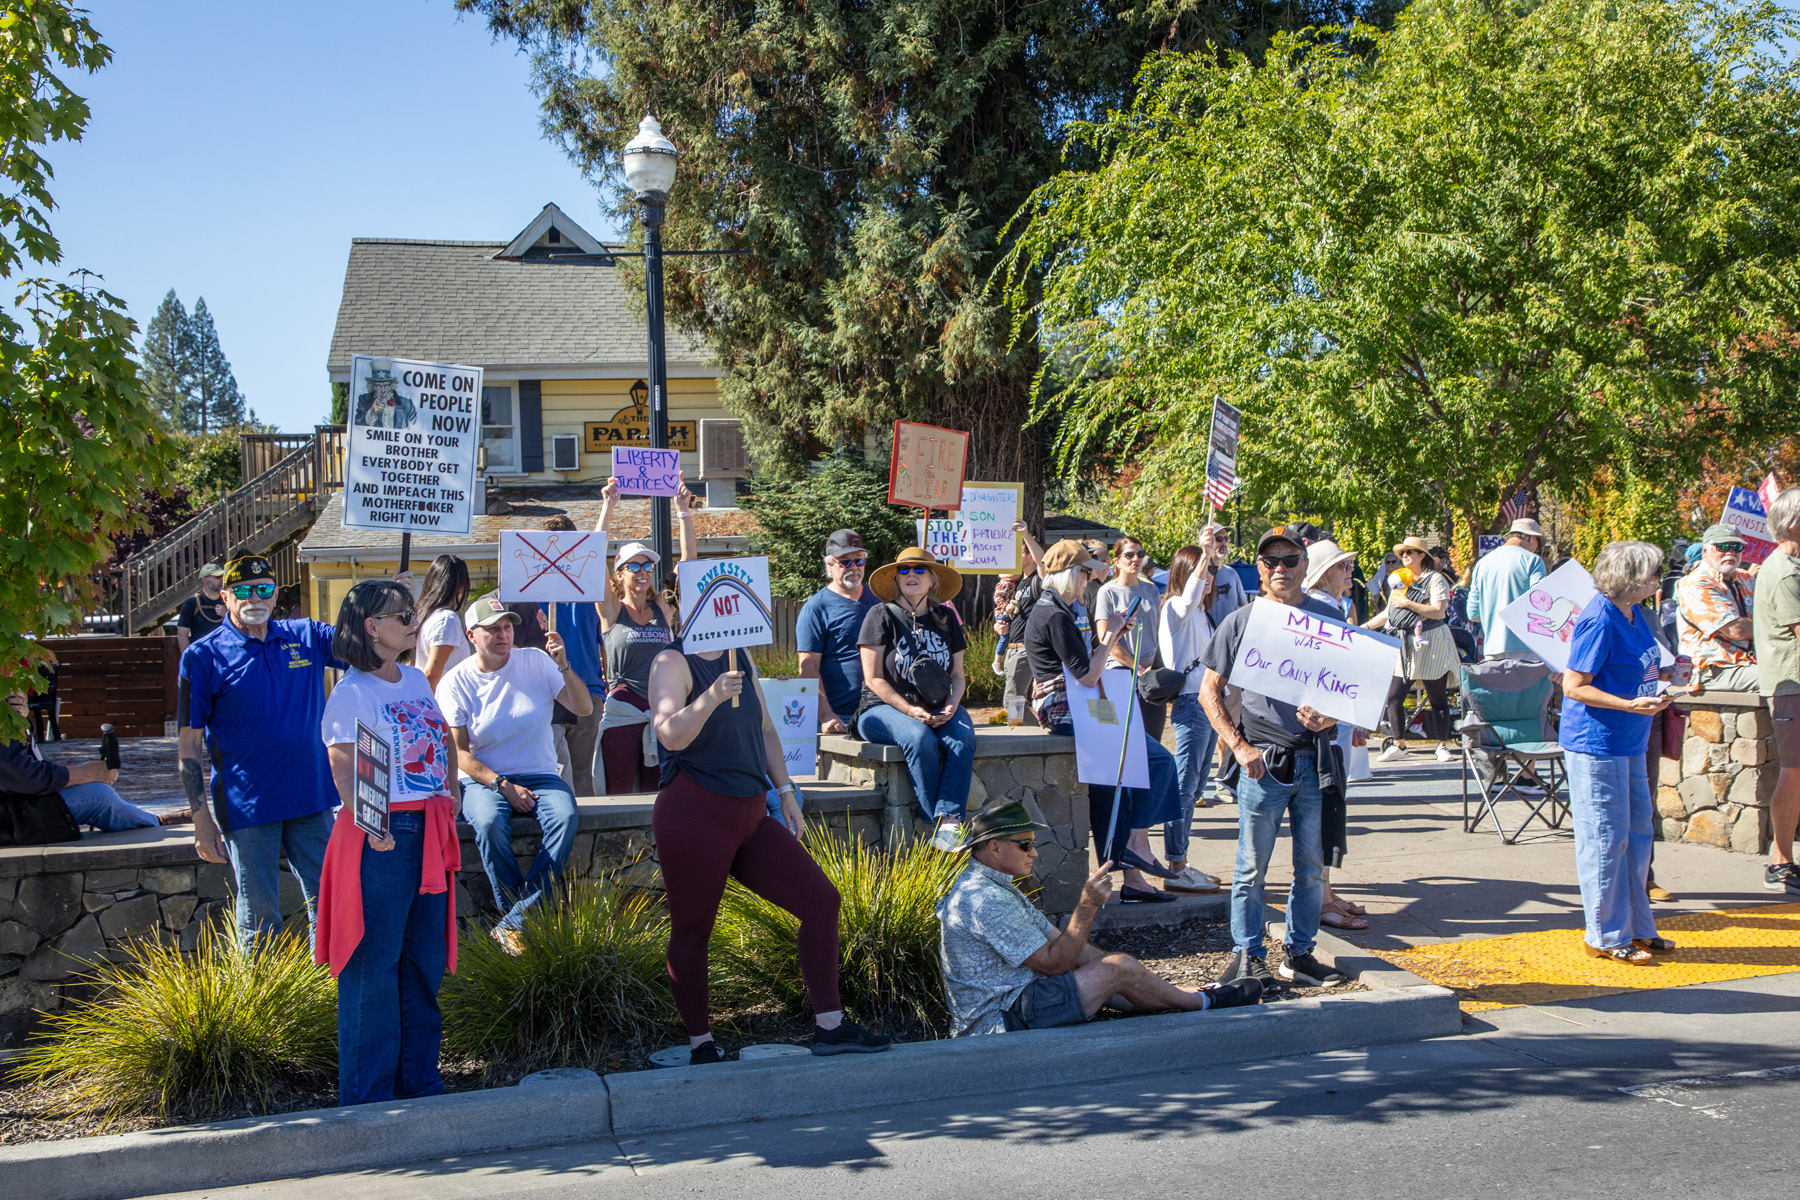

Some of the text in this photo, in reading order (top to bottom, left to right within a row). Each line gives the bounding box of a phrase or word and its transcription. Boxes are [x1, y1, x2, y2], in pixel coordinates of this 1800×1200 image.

[403, 371, 474, 393] COME ON
[420, 393, 472, 413] PEOPLE
[432, 415, 471, 433] NOW
[366, 430, 459, 447] SMILE ON YOUR
[386, 445, 438, 459] BROTHER
[616, 449, 679, 470] LIBERTY
[916, 436, 956, 471] FIRE
[362, 456, 459, 474] EVERYBODY GET
[638, 466, 648, 479] &
[381, 471, 440, 486] TOGETHER
[615, 475, 664, 490] JUSTICE
[353, 483, 464, 501] AND IMPEACH THIS
[914, 477, 948, 501] LIAR
[370, 511, 440, 526] RIGHT NOW
[969, 511, 995, 521] SON
[1728, 513, 1766, 533] CONSTI
[928, 521, 964, 532] STOP
[972, 528, 1014, 540] PATIENCE
[971, 543, 1003, 551] ASCIST
[697, 562, 753, 594] DIVERSITY
[713, 594, 740, 617] NOT
[627, 631, 669, 640] AWESOME
[692, 626, 764, 642] DICTATORSHIP
[1287, 611, 1357, 643] MLK
[1294, 636, 1322, 650] WAS
[1244, 648, 1272, 669] Our
[370, 737, 388, 767] HATE
[391, 725, 405, 794] FREEDOM DEMOCRACY
[358, 780, 387, 814] AMERICA
[362, 803, 382, 831] GREAT
